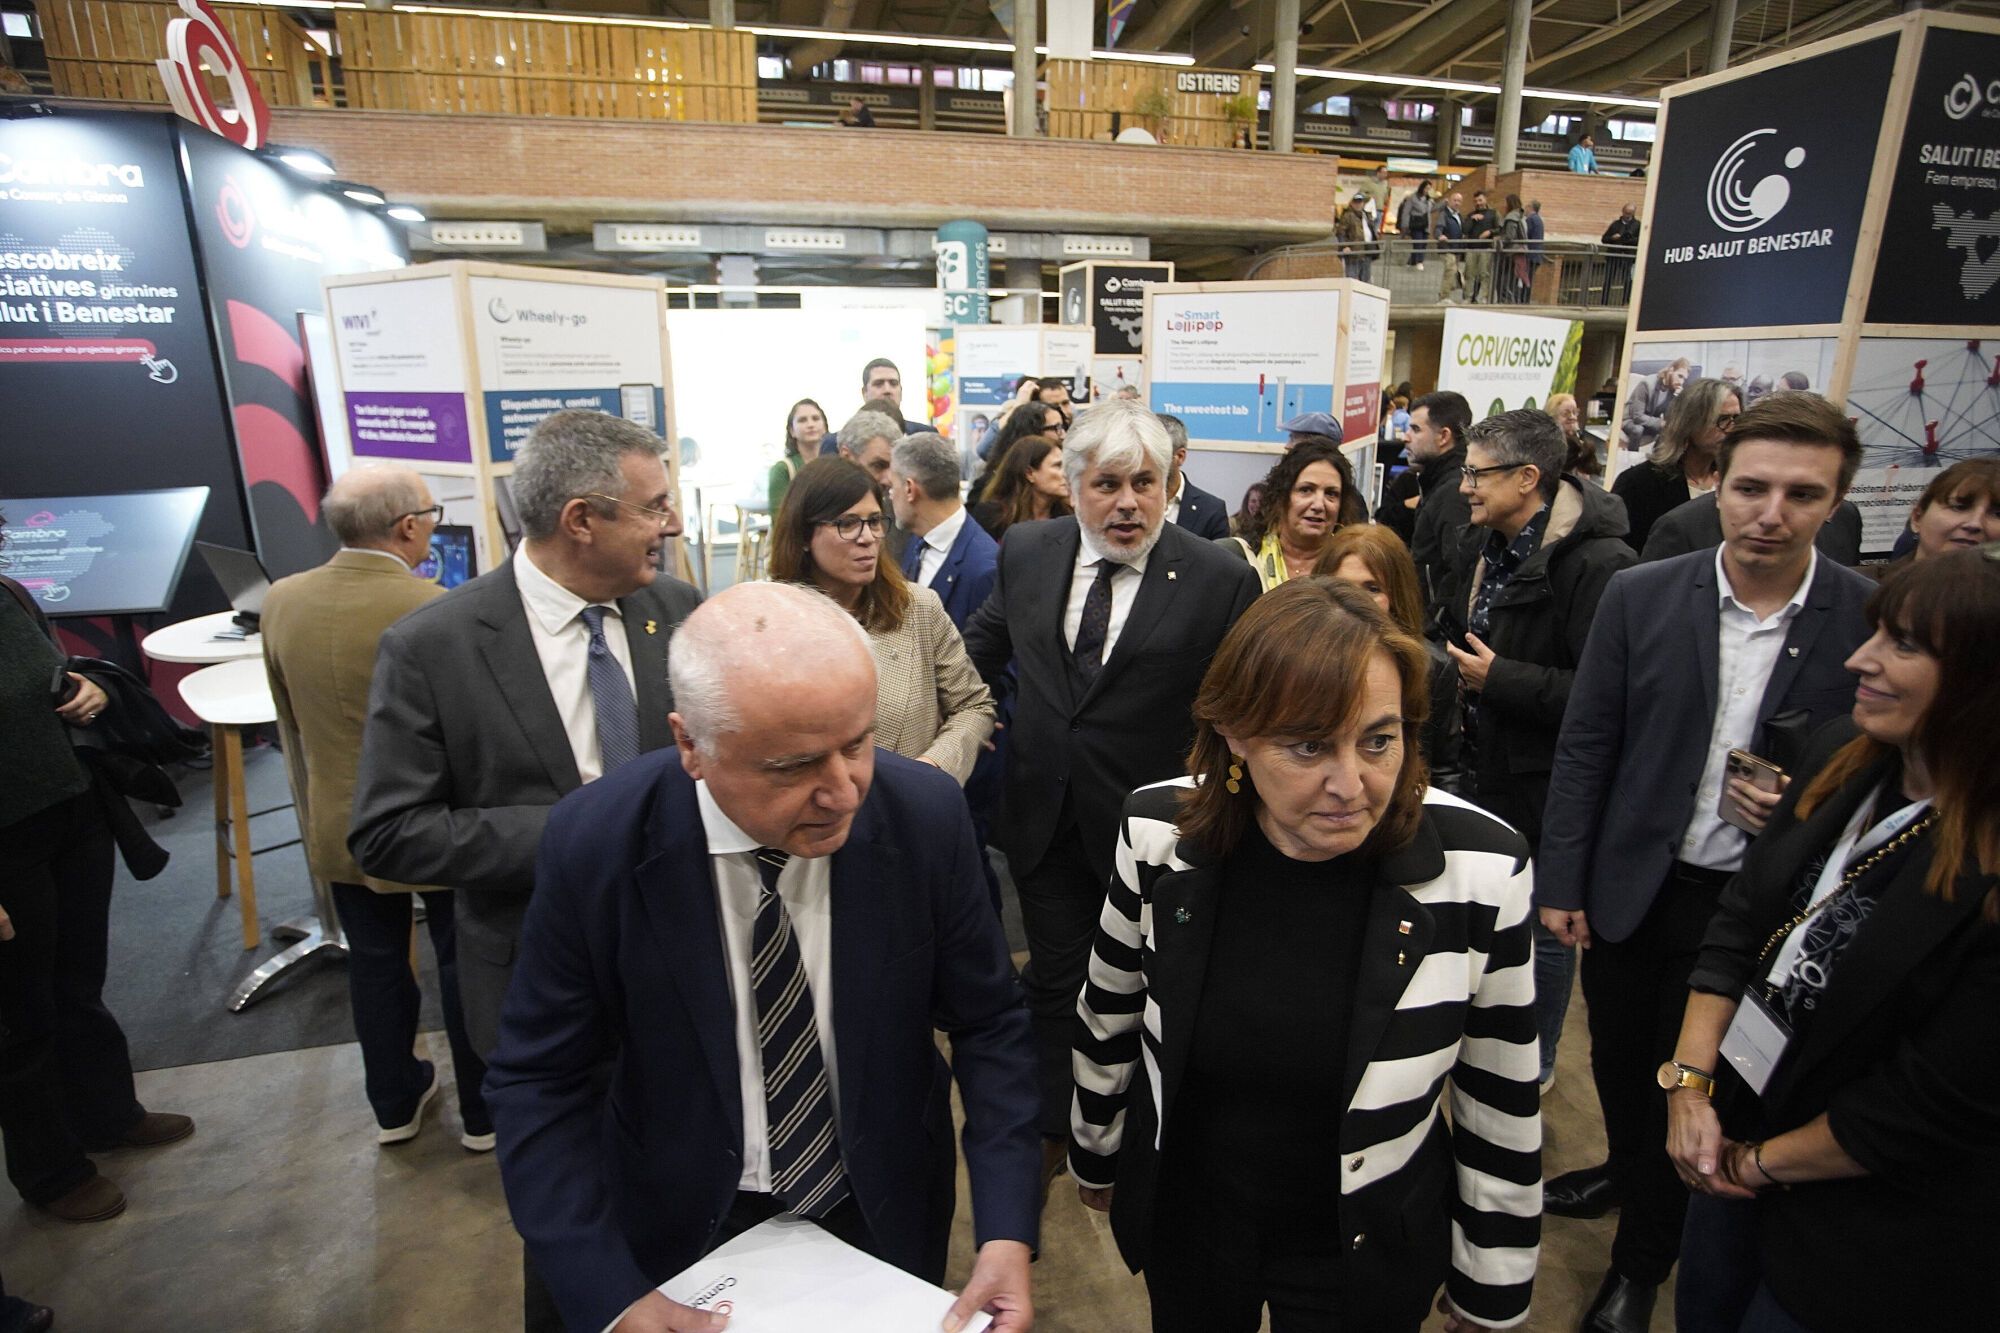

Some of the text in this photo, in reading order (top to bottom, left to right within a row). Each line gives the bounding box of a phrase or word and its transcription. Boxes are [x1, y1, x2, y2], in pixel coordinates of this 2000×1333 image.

[1177, 72, 1240, 93] OSTRENS
[1920, 144, 1975, 166] SALUT
[1974, 148, 1982, 168] I
[1925, 170, 1949, 185] Fem
[1664, 229, 1833, 264] HUB SALUT BENESTAR
[100, 284, 178, 300] gironines
[1100, 298, 1121, 306] SALUT
[41, 301, 52, 323] i
[56, 301, 175, 323] Benestar
[516, 309, 587, 327] Wheely-go
[1184, 310, 1220, 320] Smart
[1167, 320, 1224, 333] Lollipop
[1456, 333, 1556, 368] CORVIGRASS
[1163, 403, 1249, 416] The sweetest lab
